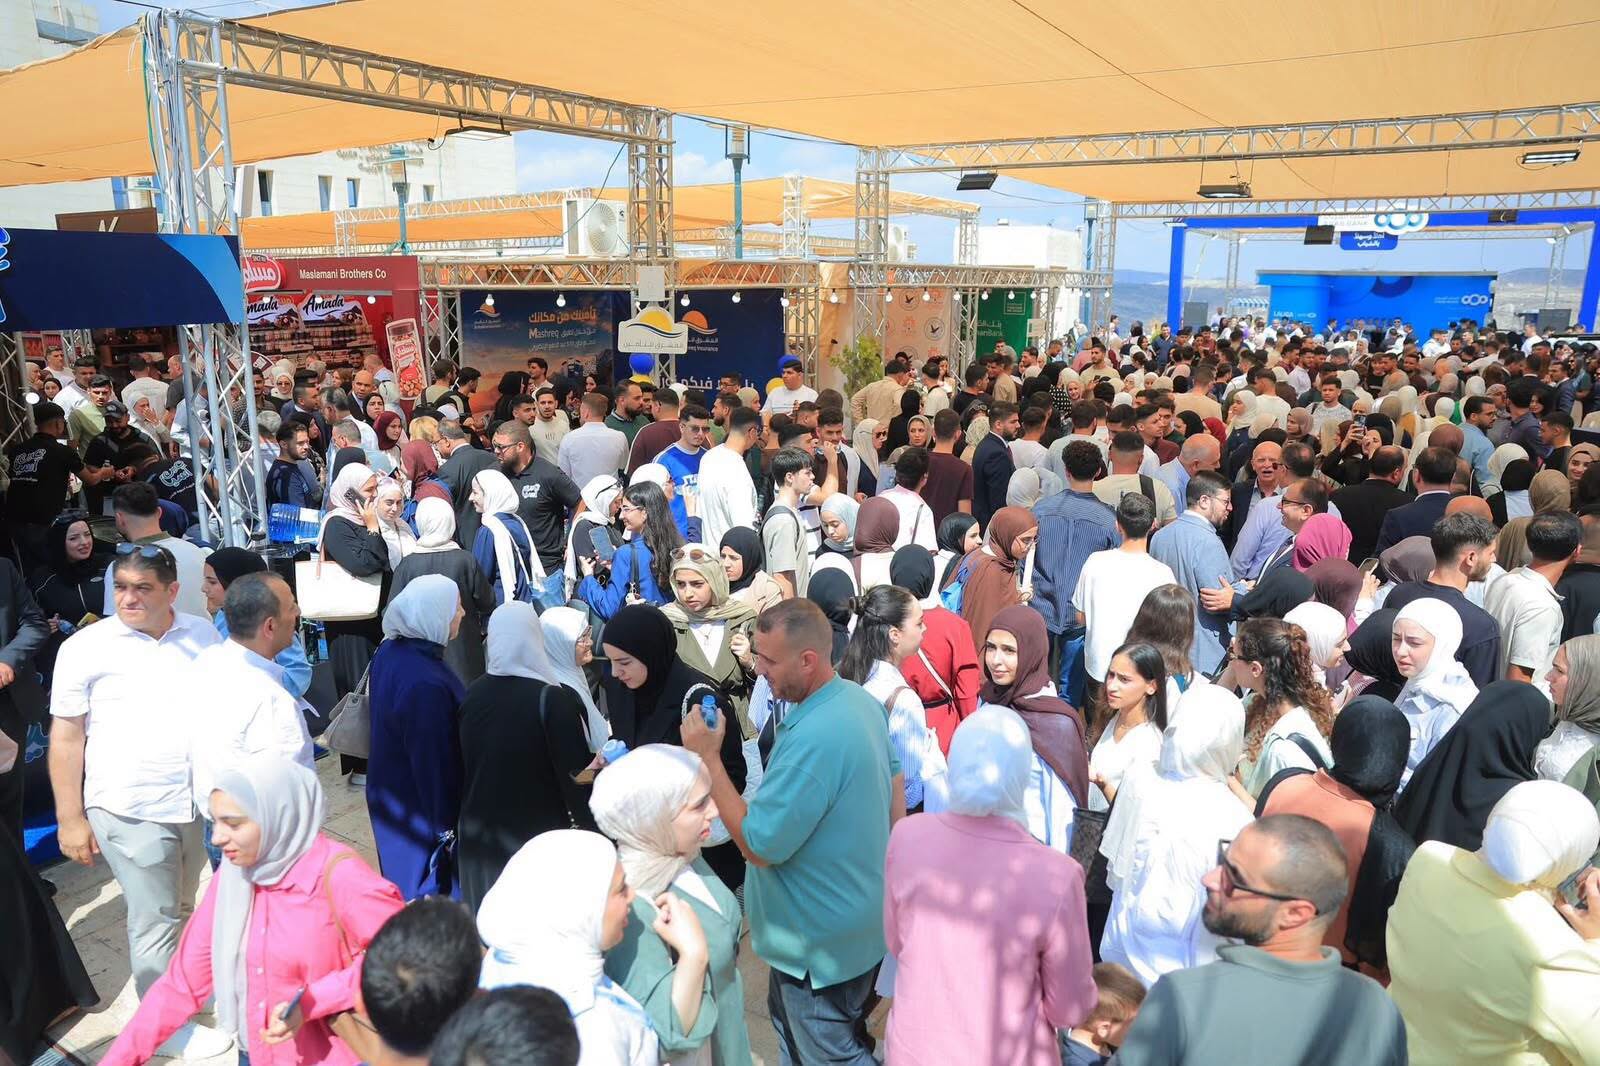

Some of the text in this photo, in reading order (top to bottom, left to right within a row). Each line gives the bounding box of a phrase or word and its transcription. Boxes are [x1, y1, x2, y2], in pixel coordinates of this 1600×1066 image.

[300, 268, 387, 280] Maslamani Brothers Co
[247, 295, 279, 314] mada
[303, 294, 345, 315] Amada
[528, 311, 556, 324] مكانك
[528, 327, 559, 340] Mashreq
